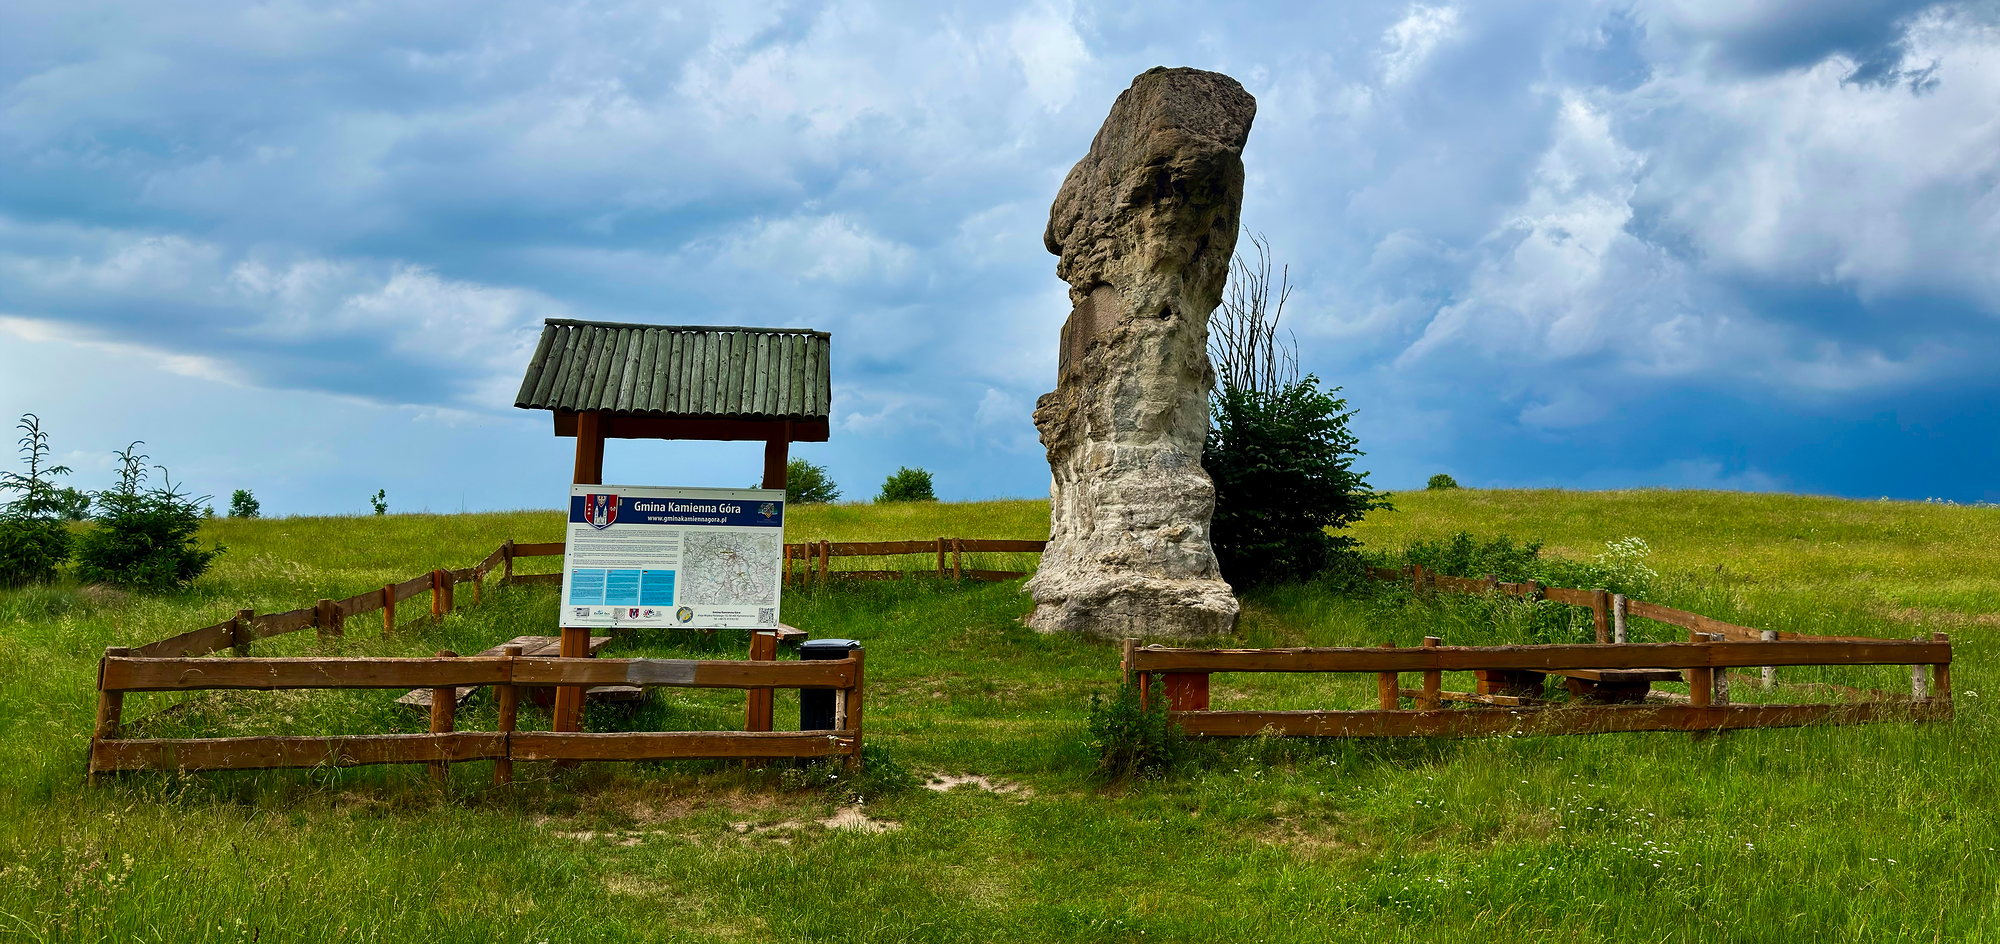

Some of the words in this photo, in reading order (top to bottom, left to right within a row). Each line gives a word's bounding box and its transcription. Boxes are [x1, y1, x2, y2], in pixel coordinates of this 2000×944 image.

[634, 501, 665, 512] Gmina
[668, 502, 717, 513] Kamienna
[719, 503, 741, 514] Góra
[647, 515, 727, 524] www.gminakamiennagora.pl
